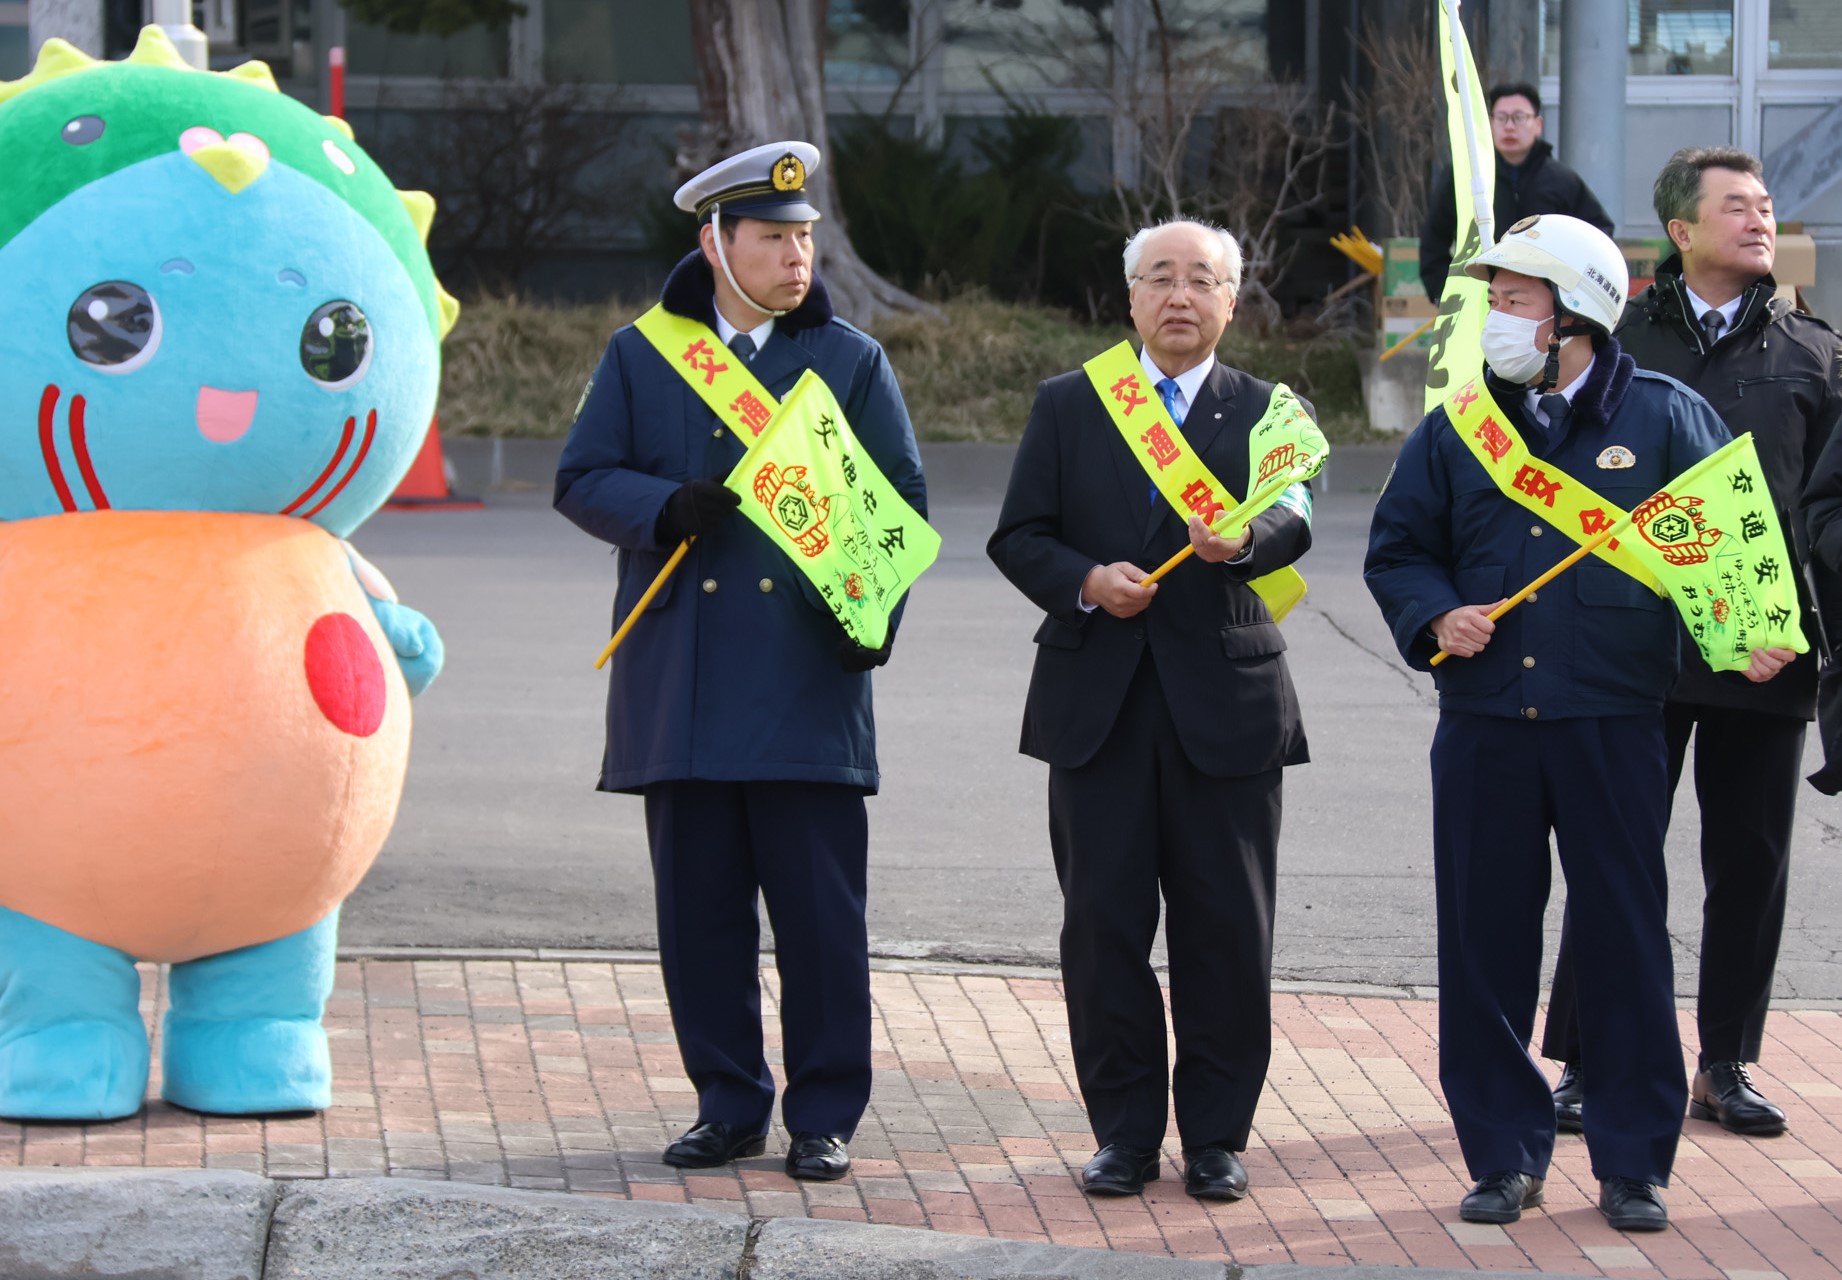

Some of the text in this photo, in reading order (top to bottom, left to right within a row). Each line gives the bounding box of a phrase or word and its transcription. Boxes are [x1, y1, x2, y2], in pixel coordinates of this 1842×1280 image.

[681, 338, 773, 437] 交通
[1727, 468, 1792, 634] 交通安全
